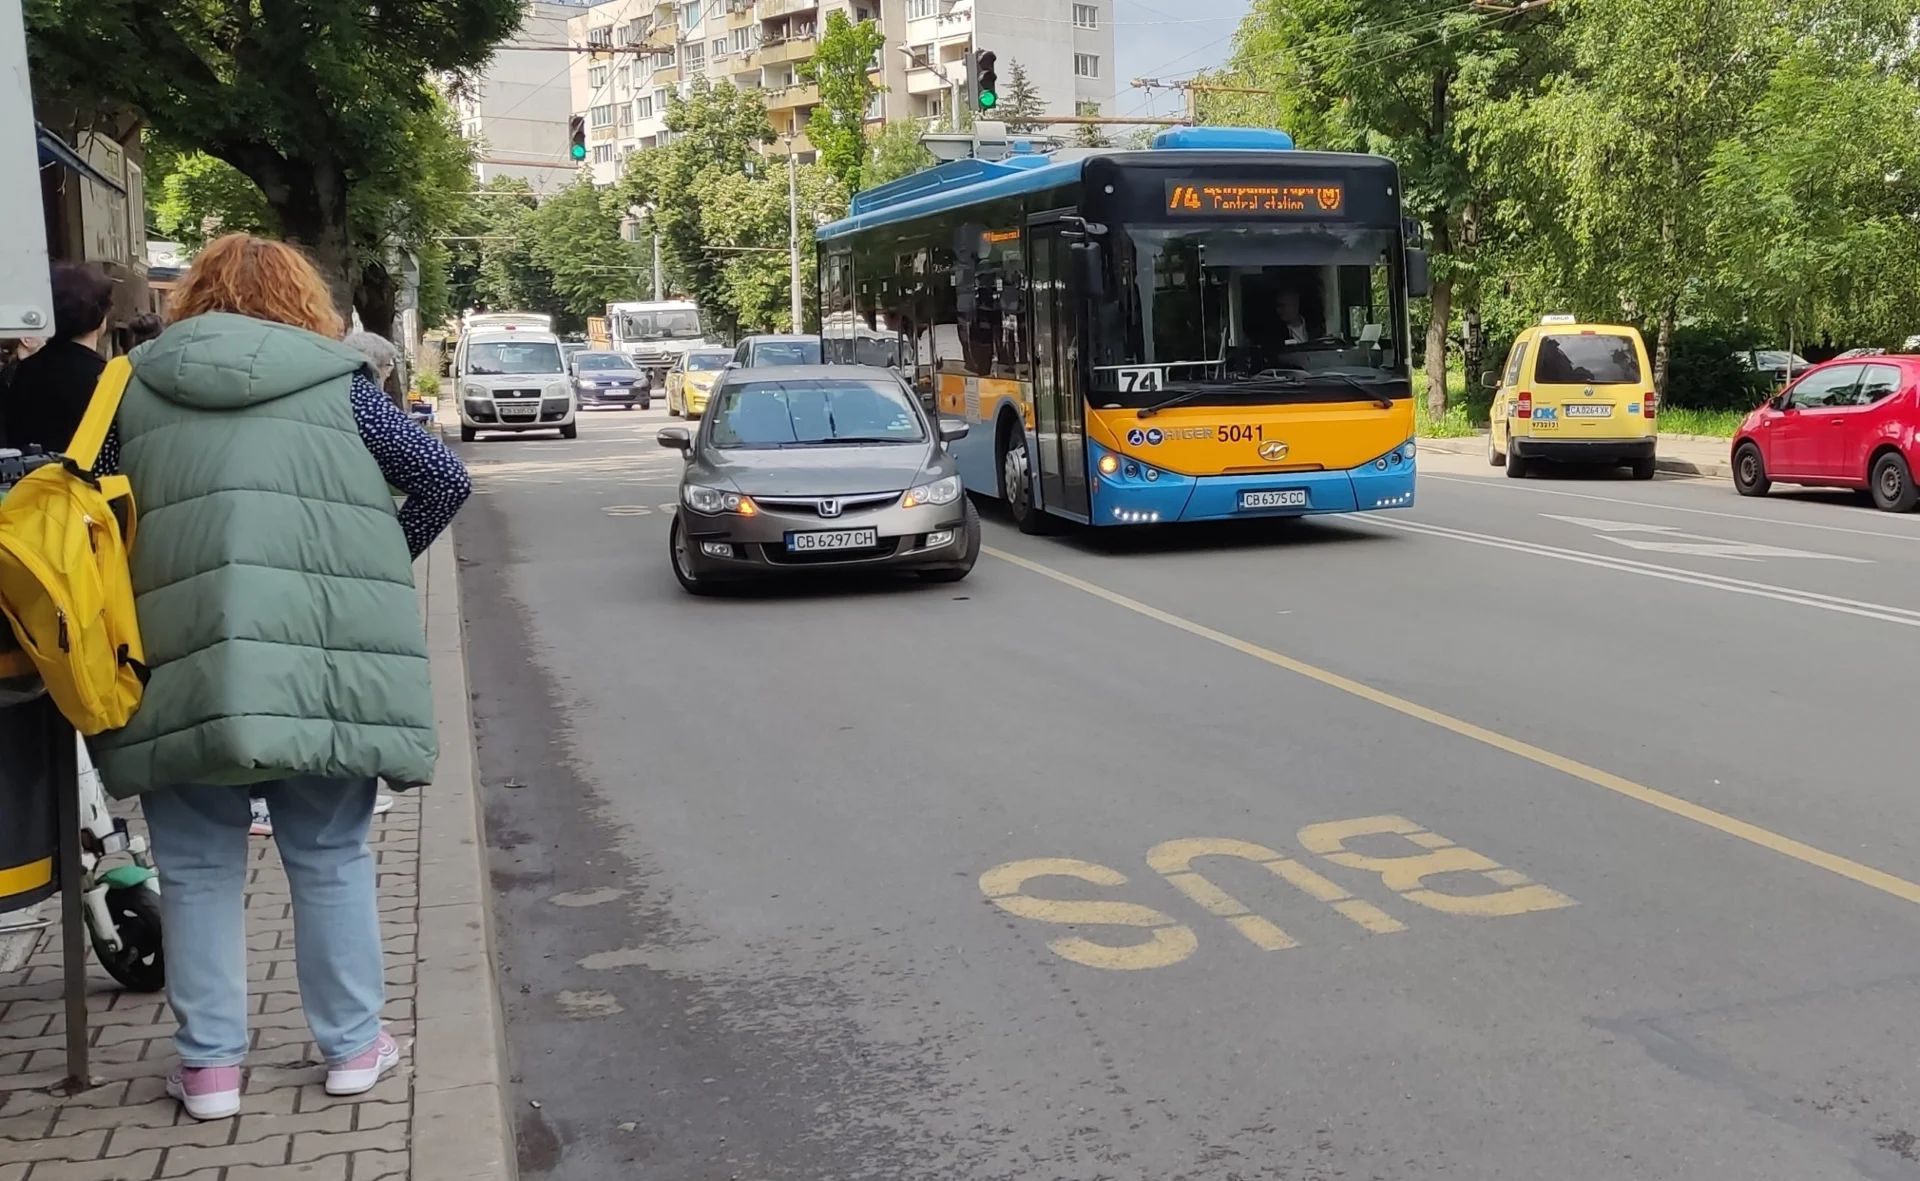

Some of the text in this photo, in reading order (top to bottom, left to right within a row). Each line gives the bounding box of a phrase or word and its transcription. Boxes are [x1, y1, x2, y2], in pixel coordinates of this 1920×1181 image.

[1121, 371, 1158, 392] 74
[1163, 424, 1263, 442] HIGER 5041
[1246, 492, 1304, 506] CB 6375 CC
[796, 531, 873, 549] CB 6297 CH
[979, 815, 1579, 971] BUS
